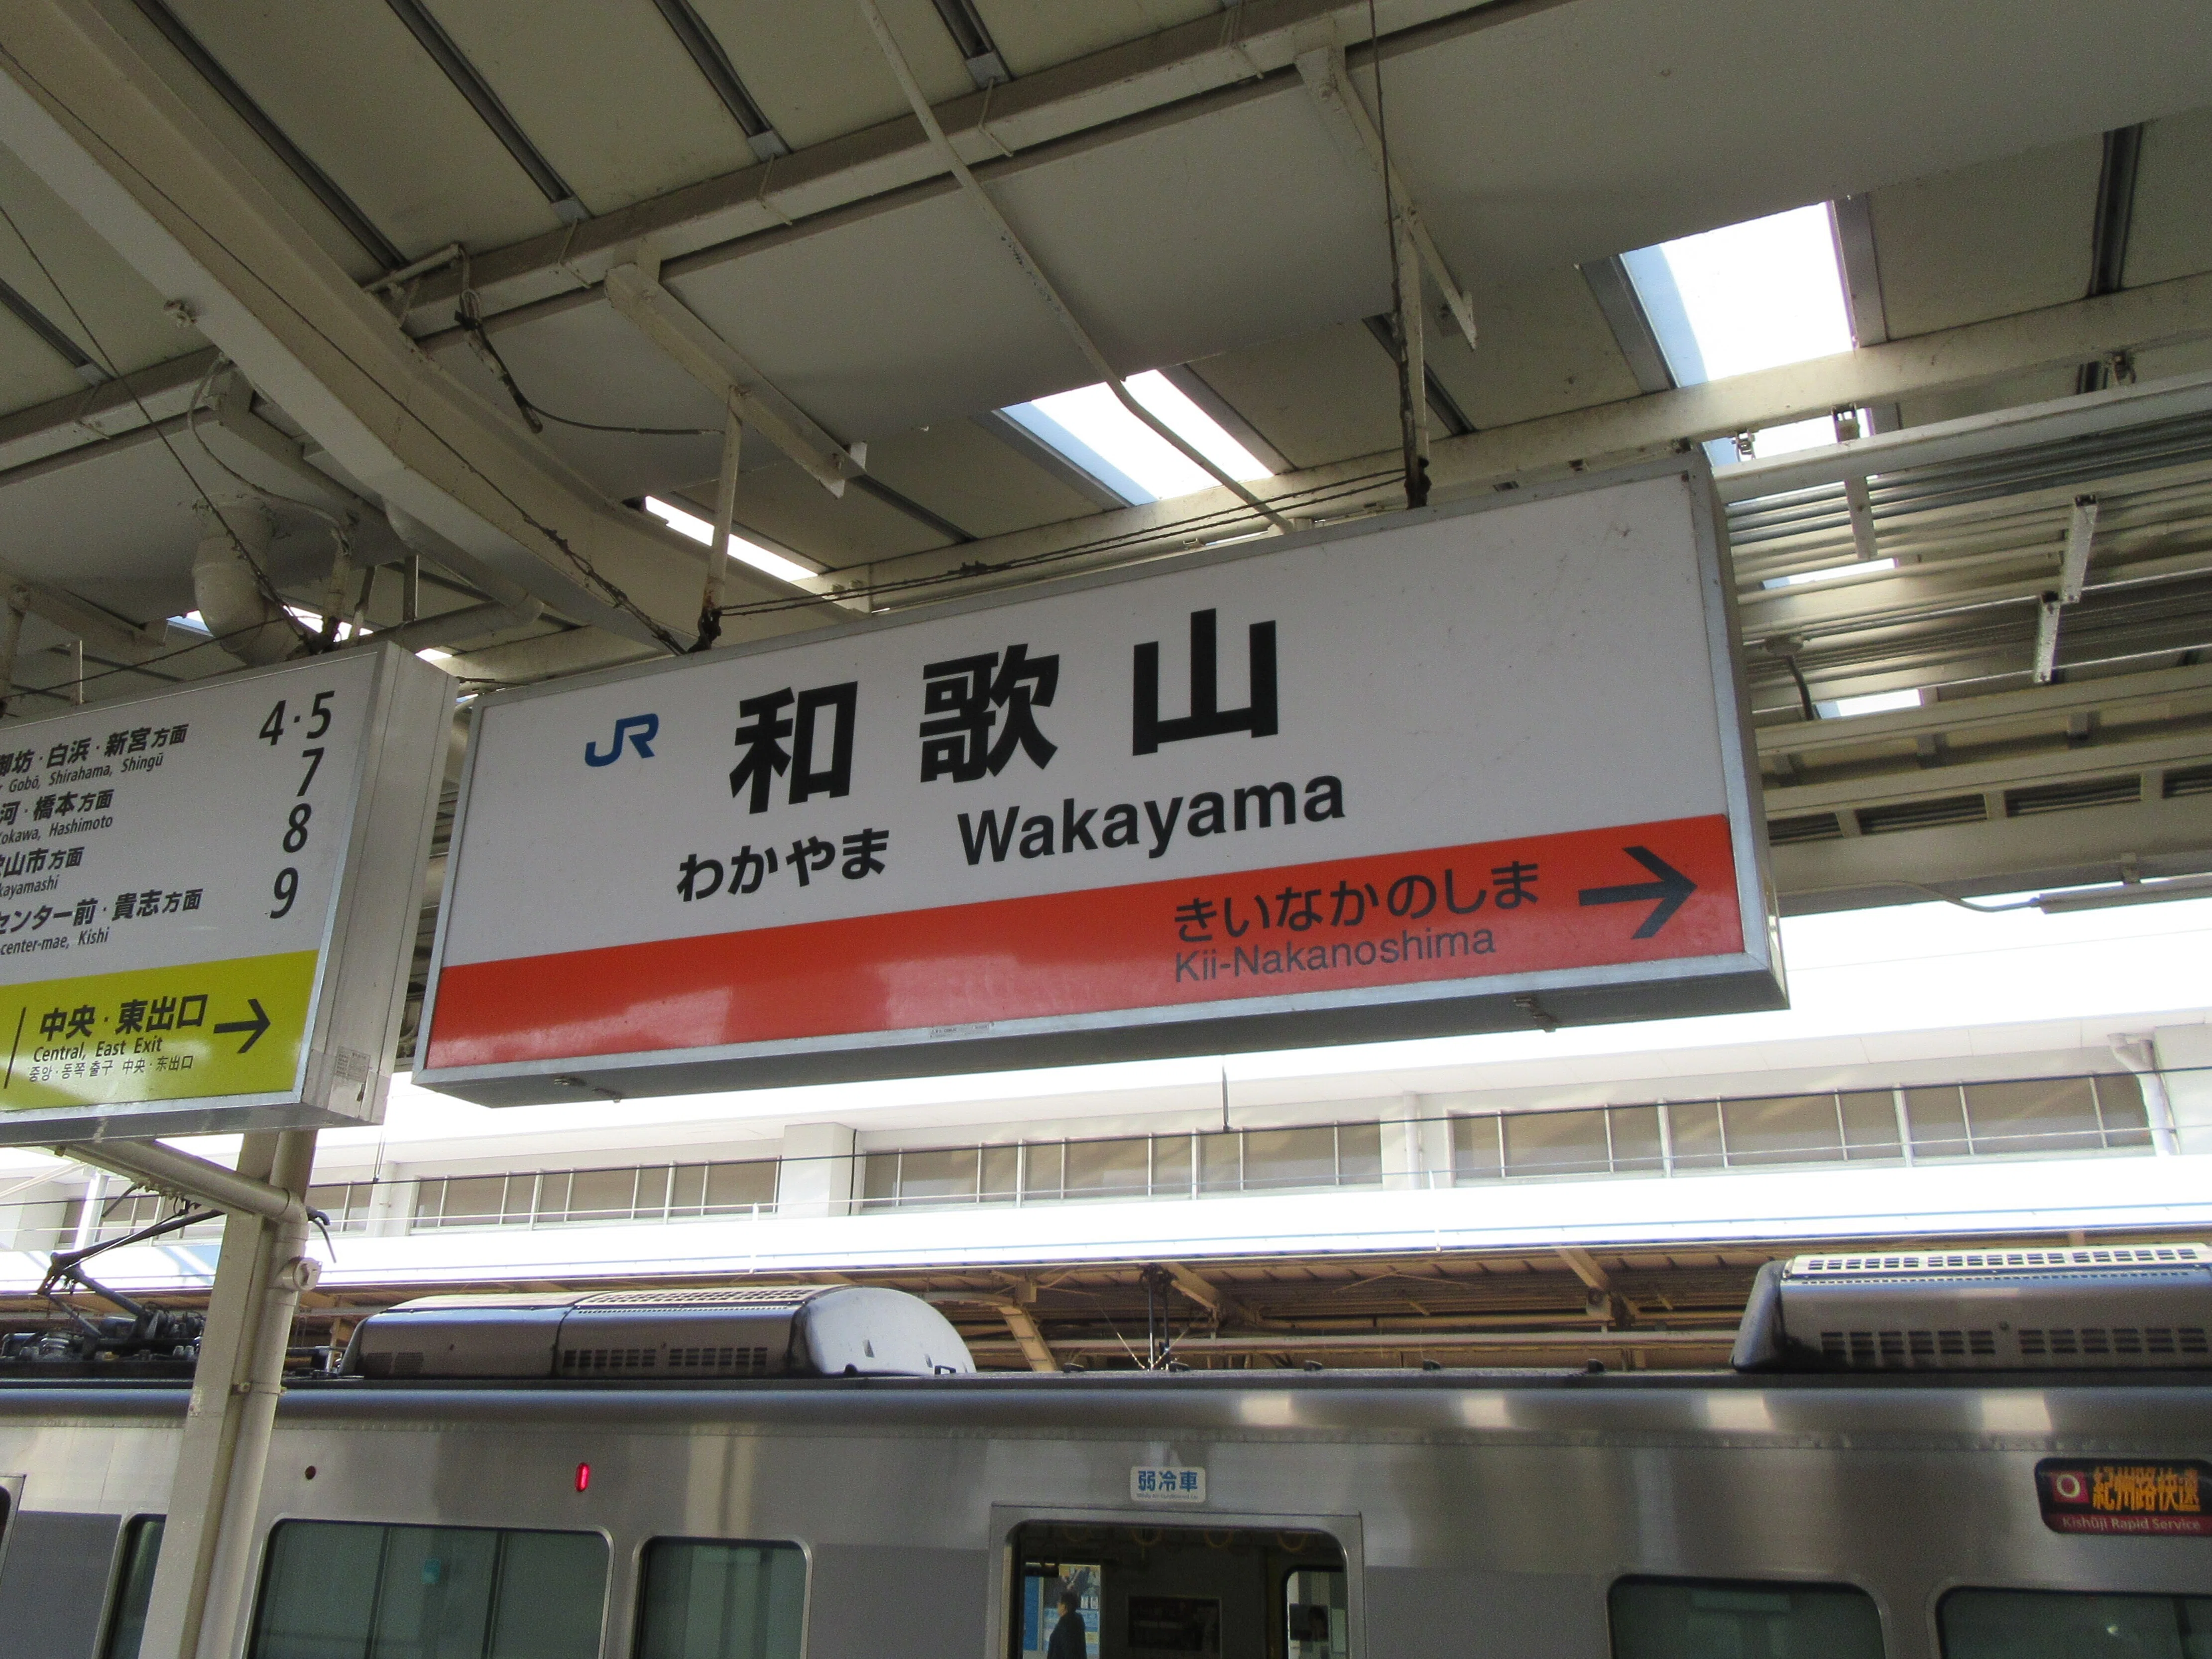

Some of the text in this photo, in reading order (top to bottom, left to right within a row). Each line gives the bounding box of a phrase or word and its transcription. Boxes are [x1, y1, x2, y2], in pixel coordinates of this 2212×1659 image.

[729, 608, 1279, 815] 和歌山
[48, 764, 112, 786] Shirahama,
[121, 752, 163, 772] Shingū
[297, 748, 324, 797] 7
[0, 815, 113, 845] okawa, Hashimoto
[282, 803, 312, 853] 8
[957, 774, 1346, 866] Wakayama
[0, 847, 85, 878] 山市方面
[677, 828, 890, 902] わかやま
[269, 868, 298, 919] 9
[1174, 861, 1539, 943] きいなかのしま
[77, 927, 110, 946] Kishi
[1174, 926, 1495, 983] Kii-Nakanoshima
[33, 1036, 163, 1062] Central, East Exit
[89, 1060, 113, 1077] 출구
[1138, 1470, 1198, 1492] 弱冷車
[2093, 1466, 2201, 1512] 紀州路快速
[2111, 1518, 2150, 1532] Rapid
[2154, 1518, 2201, 1531] Service
